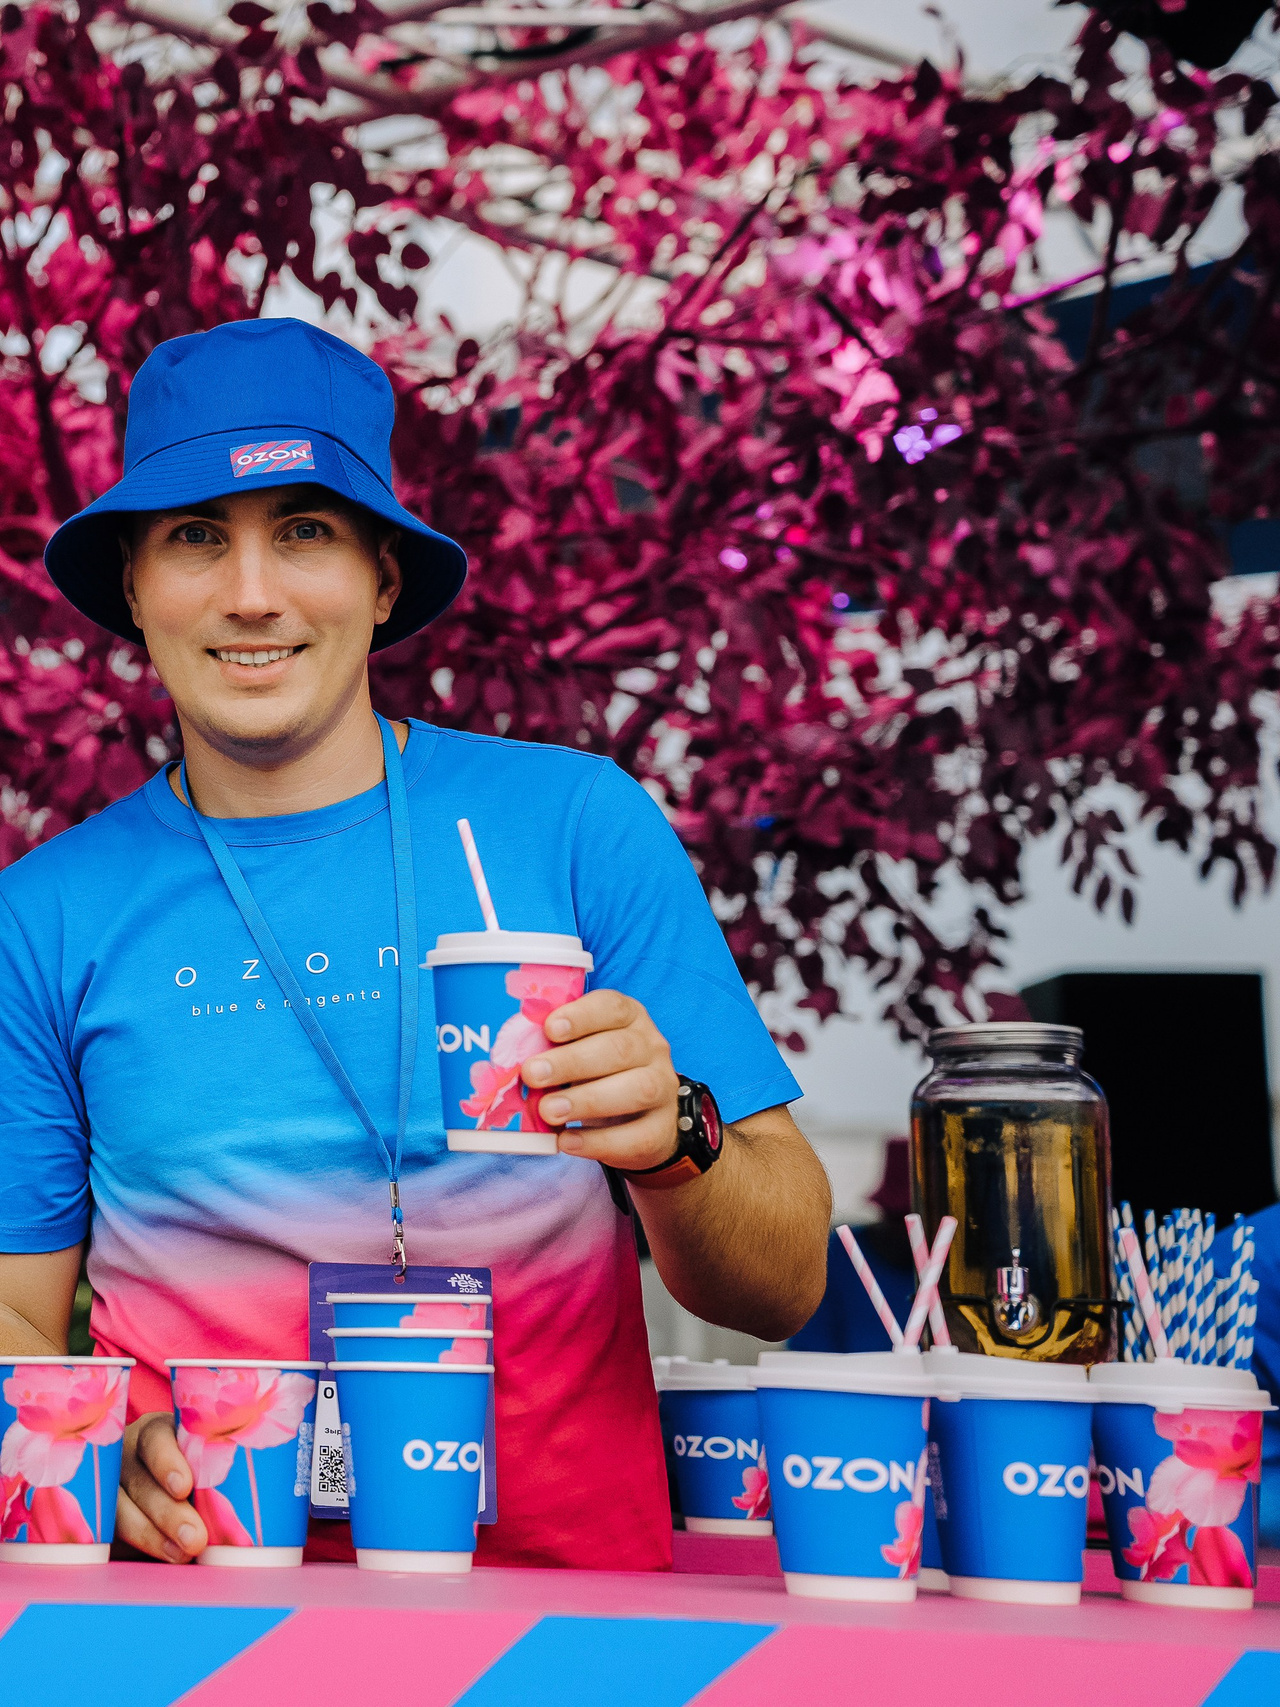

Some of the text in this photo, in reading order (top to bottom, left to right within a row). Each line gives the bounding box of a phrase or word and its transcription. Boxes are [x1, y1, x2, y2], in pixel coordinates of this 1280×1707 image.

[237, 449, 308, 466] OZON
[192, 1003, 238, 1017] blue
[255, 998, 266, 1010] &
[435, 1023, 490, 1054] ON
[447, 1277, 484, 1289] fest
[673, 1434, 758, 1460] OZON
[782, 1453, 916, 1494] OZON
